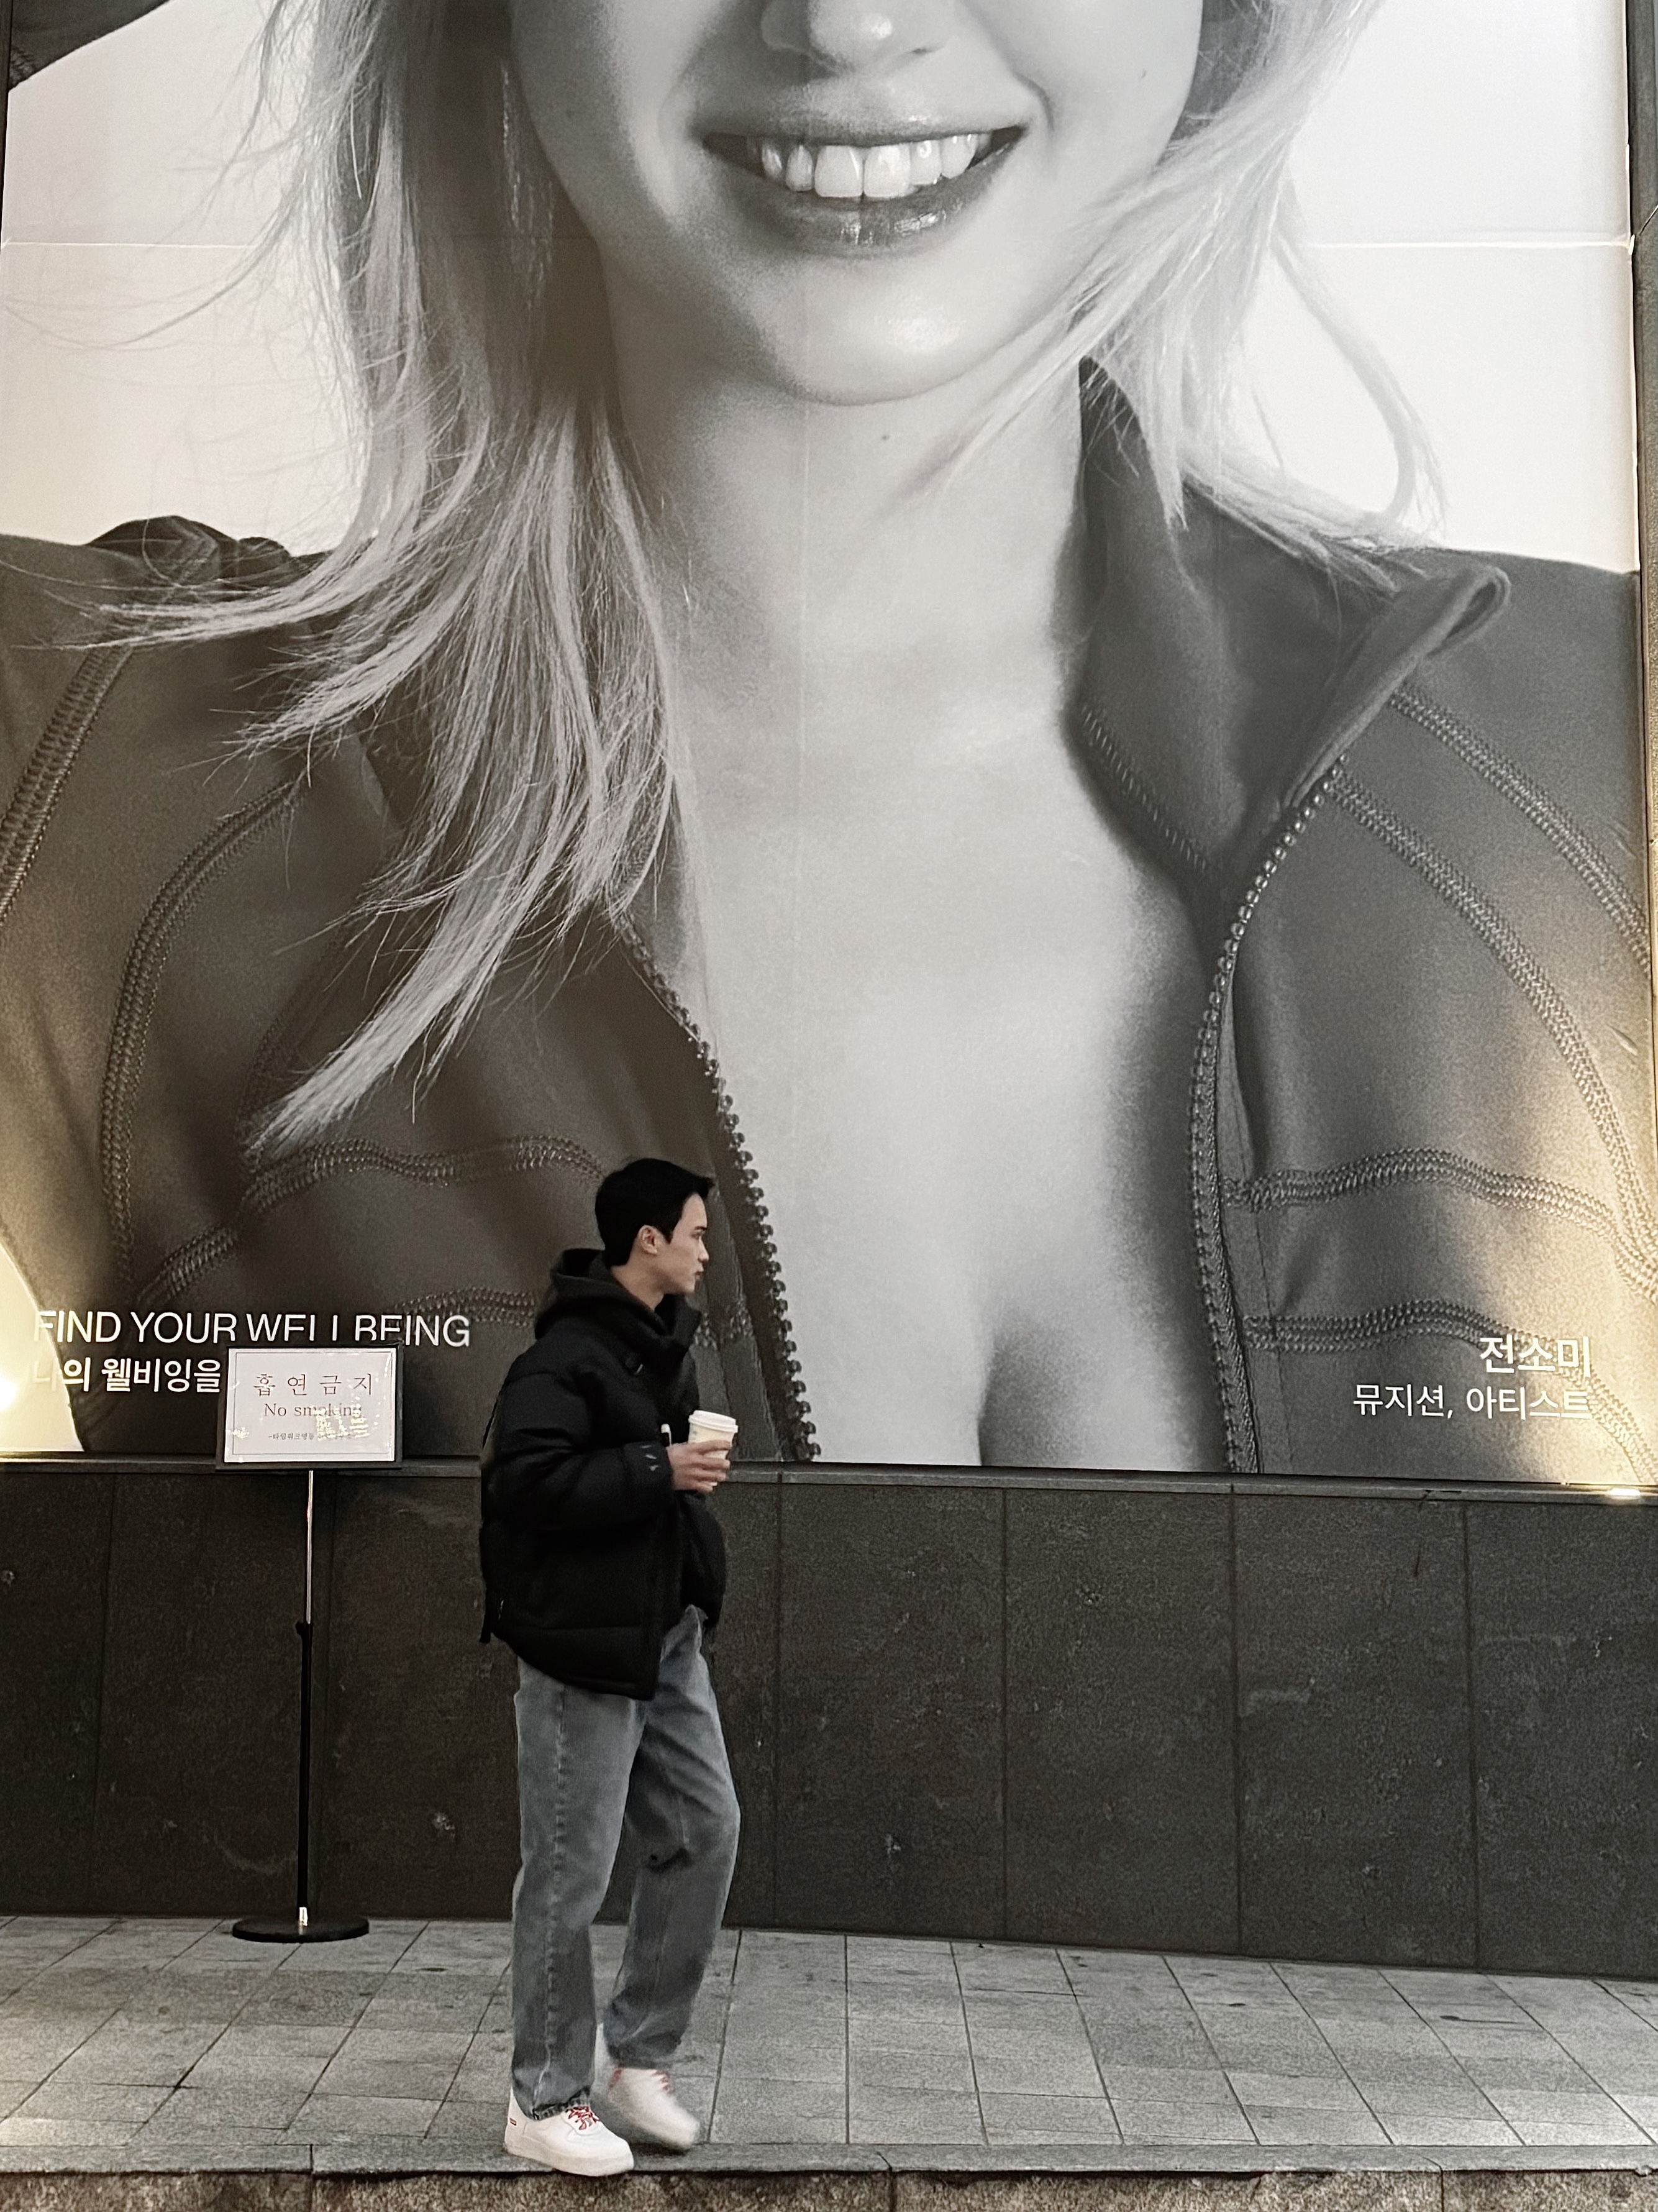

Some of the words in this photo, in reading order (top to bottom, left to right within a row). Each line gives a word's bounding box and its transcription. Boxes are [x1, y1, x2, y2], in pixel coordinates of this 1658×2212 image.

[34, 1310, 121, 1343] FIND
[130, 1311, 236, 1344] YOUR
[1480, 1334, 1591, 1378] 전소미
[101, 1358, 221, 1392] 웰비잉을
[264, 1403, 287, 1417] No
[1353, 1384, 1453, 1419] 뮤지션,
[1466, 1385, 1593, 1420] 아티스트
